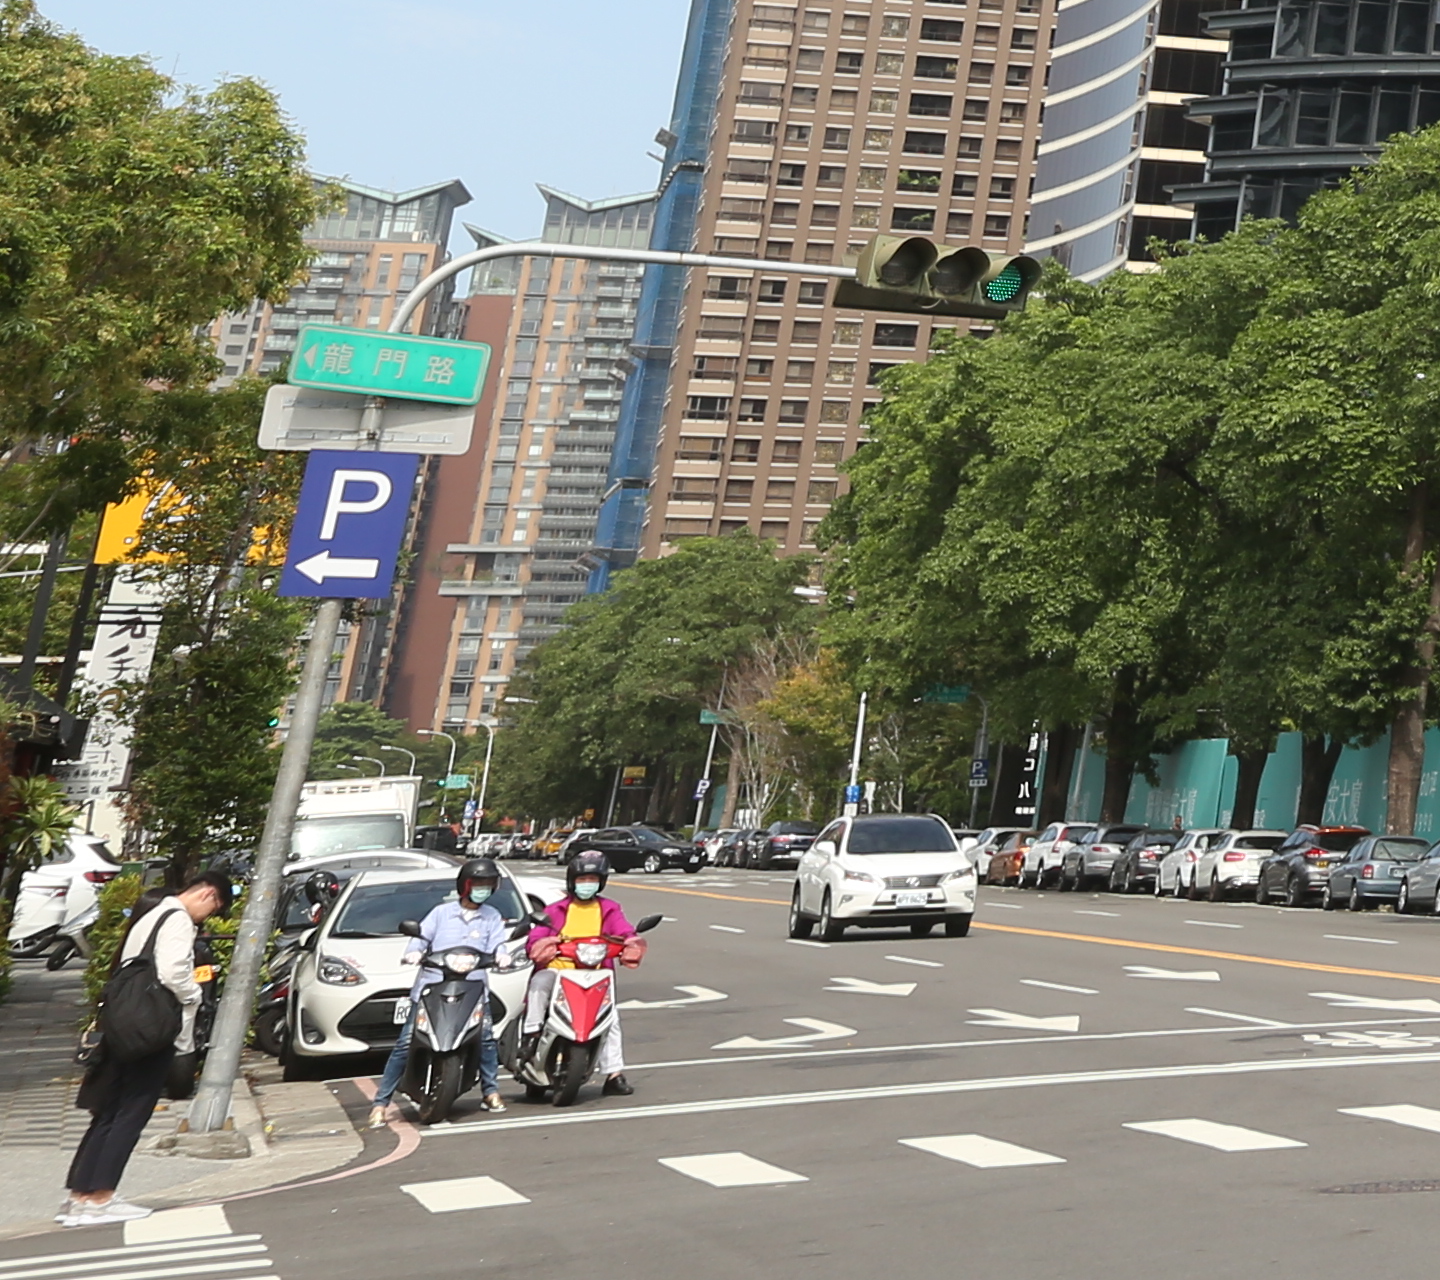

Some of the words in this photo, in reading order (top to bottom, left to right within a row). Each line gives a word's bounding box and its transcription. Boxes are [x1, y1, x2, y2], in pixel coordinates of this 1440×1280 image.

[322, 342, 457, 386] 龍門路
[319, 468, 393, 541] P
